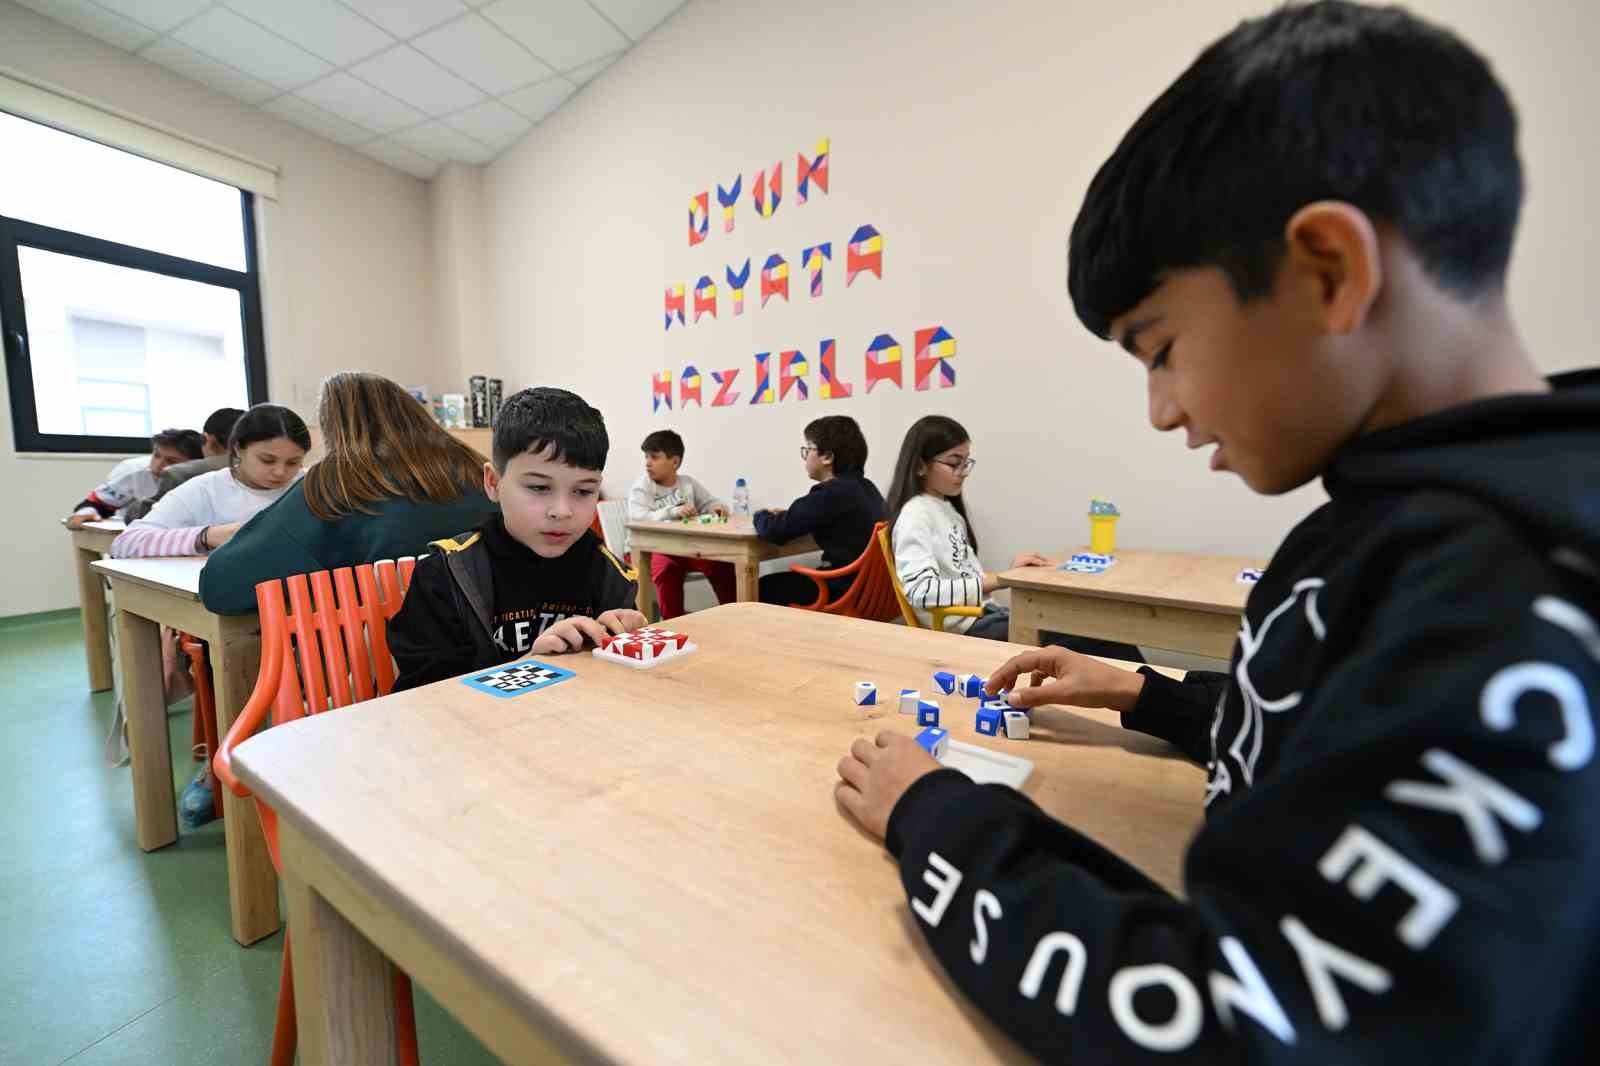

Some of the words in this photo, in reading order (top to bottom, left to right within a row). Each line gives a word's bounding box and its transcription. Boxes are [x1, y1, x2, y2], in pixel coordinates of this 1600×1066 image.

[688, 136, 830, 247] OYUN
[664, 223, 883, 331] HAYATA
[652, 325, 957, 413] HAZIRLAR
